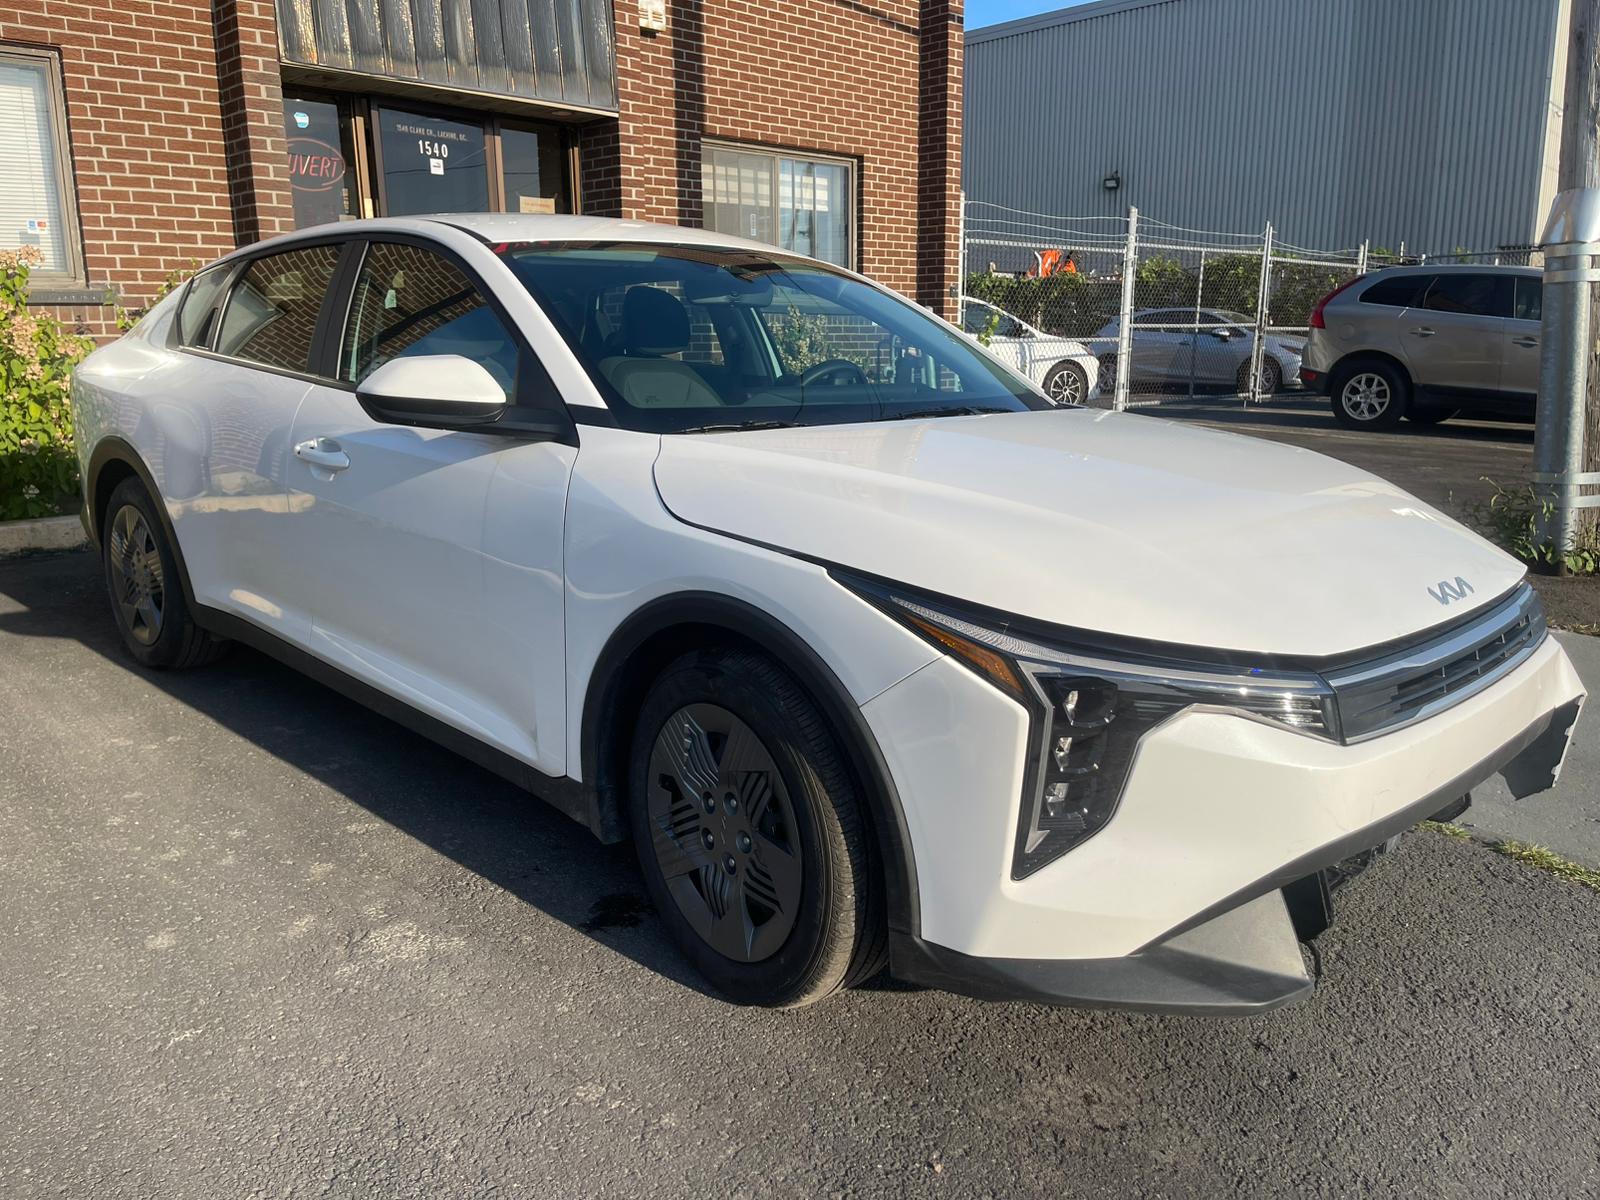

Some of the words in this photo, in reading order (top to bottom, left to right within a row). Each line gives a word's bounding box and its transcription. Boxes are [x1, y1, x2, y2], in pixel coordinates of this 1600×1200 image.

[418, 140, 448, 158] 1540
[287, 154, 340, 178] UVERT
[1427, 576, 1475, 605] KIA
